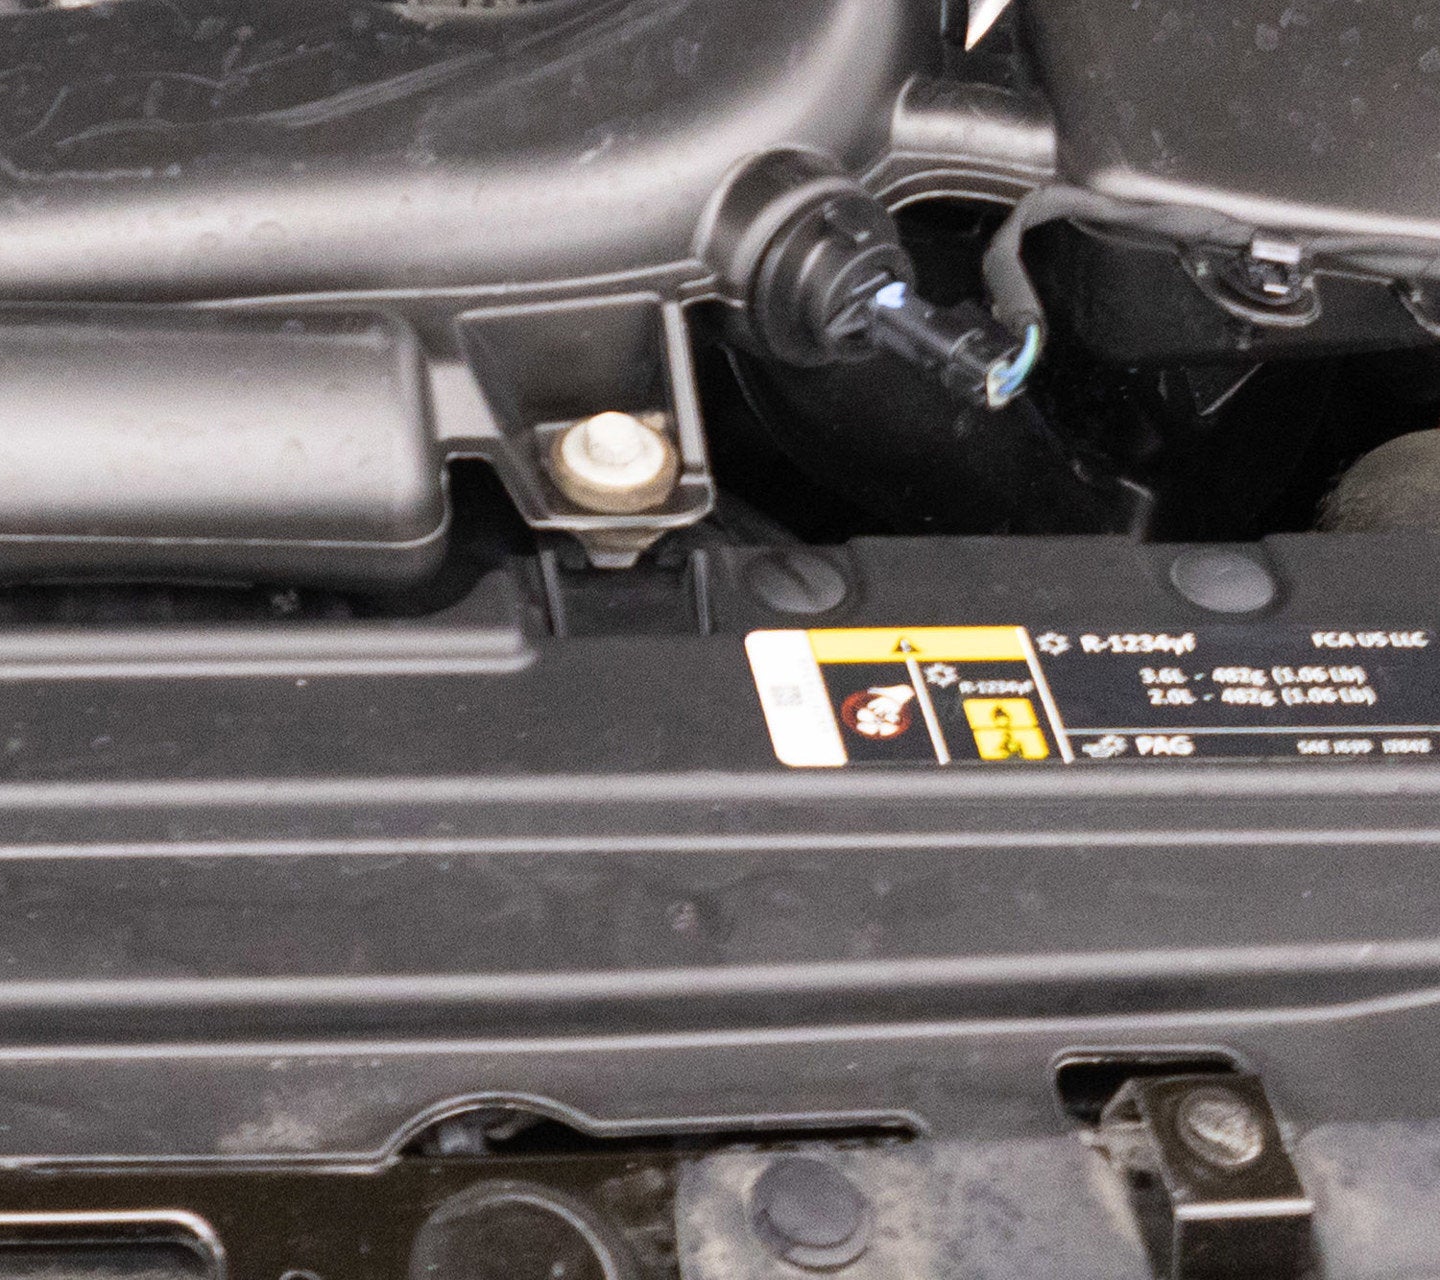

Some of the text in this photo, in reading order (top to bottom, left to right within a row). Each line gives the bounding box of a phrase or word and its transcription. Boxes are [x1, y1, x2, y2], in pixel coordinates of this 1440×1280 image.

[1080, 632, 1196, 656] R-1234yf
[1311, 630, 1429, 648] FCA US LLC
[1135, 735, 1195, 757] PAG
